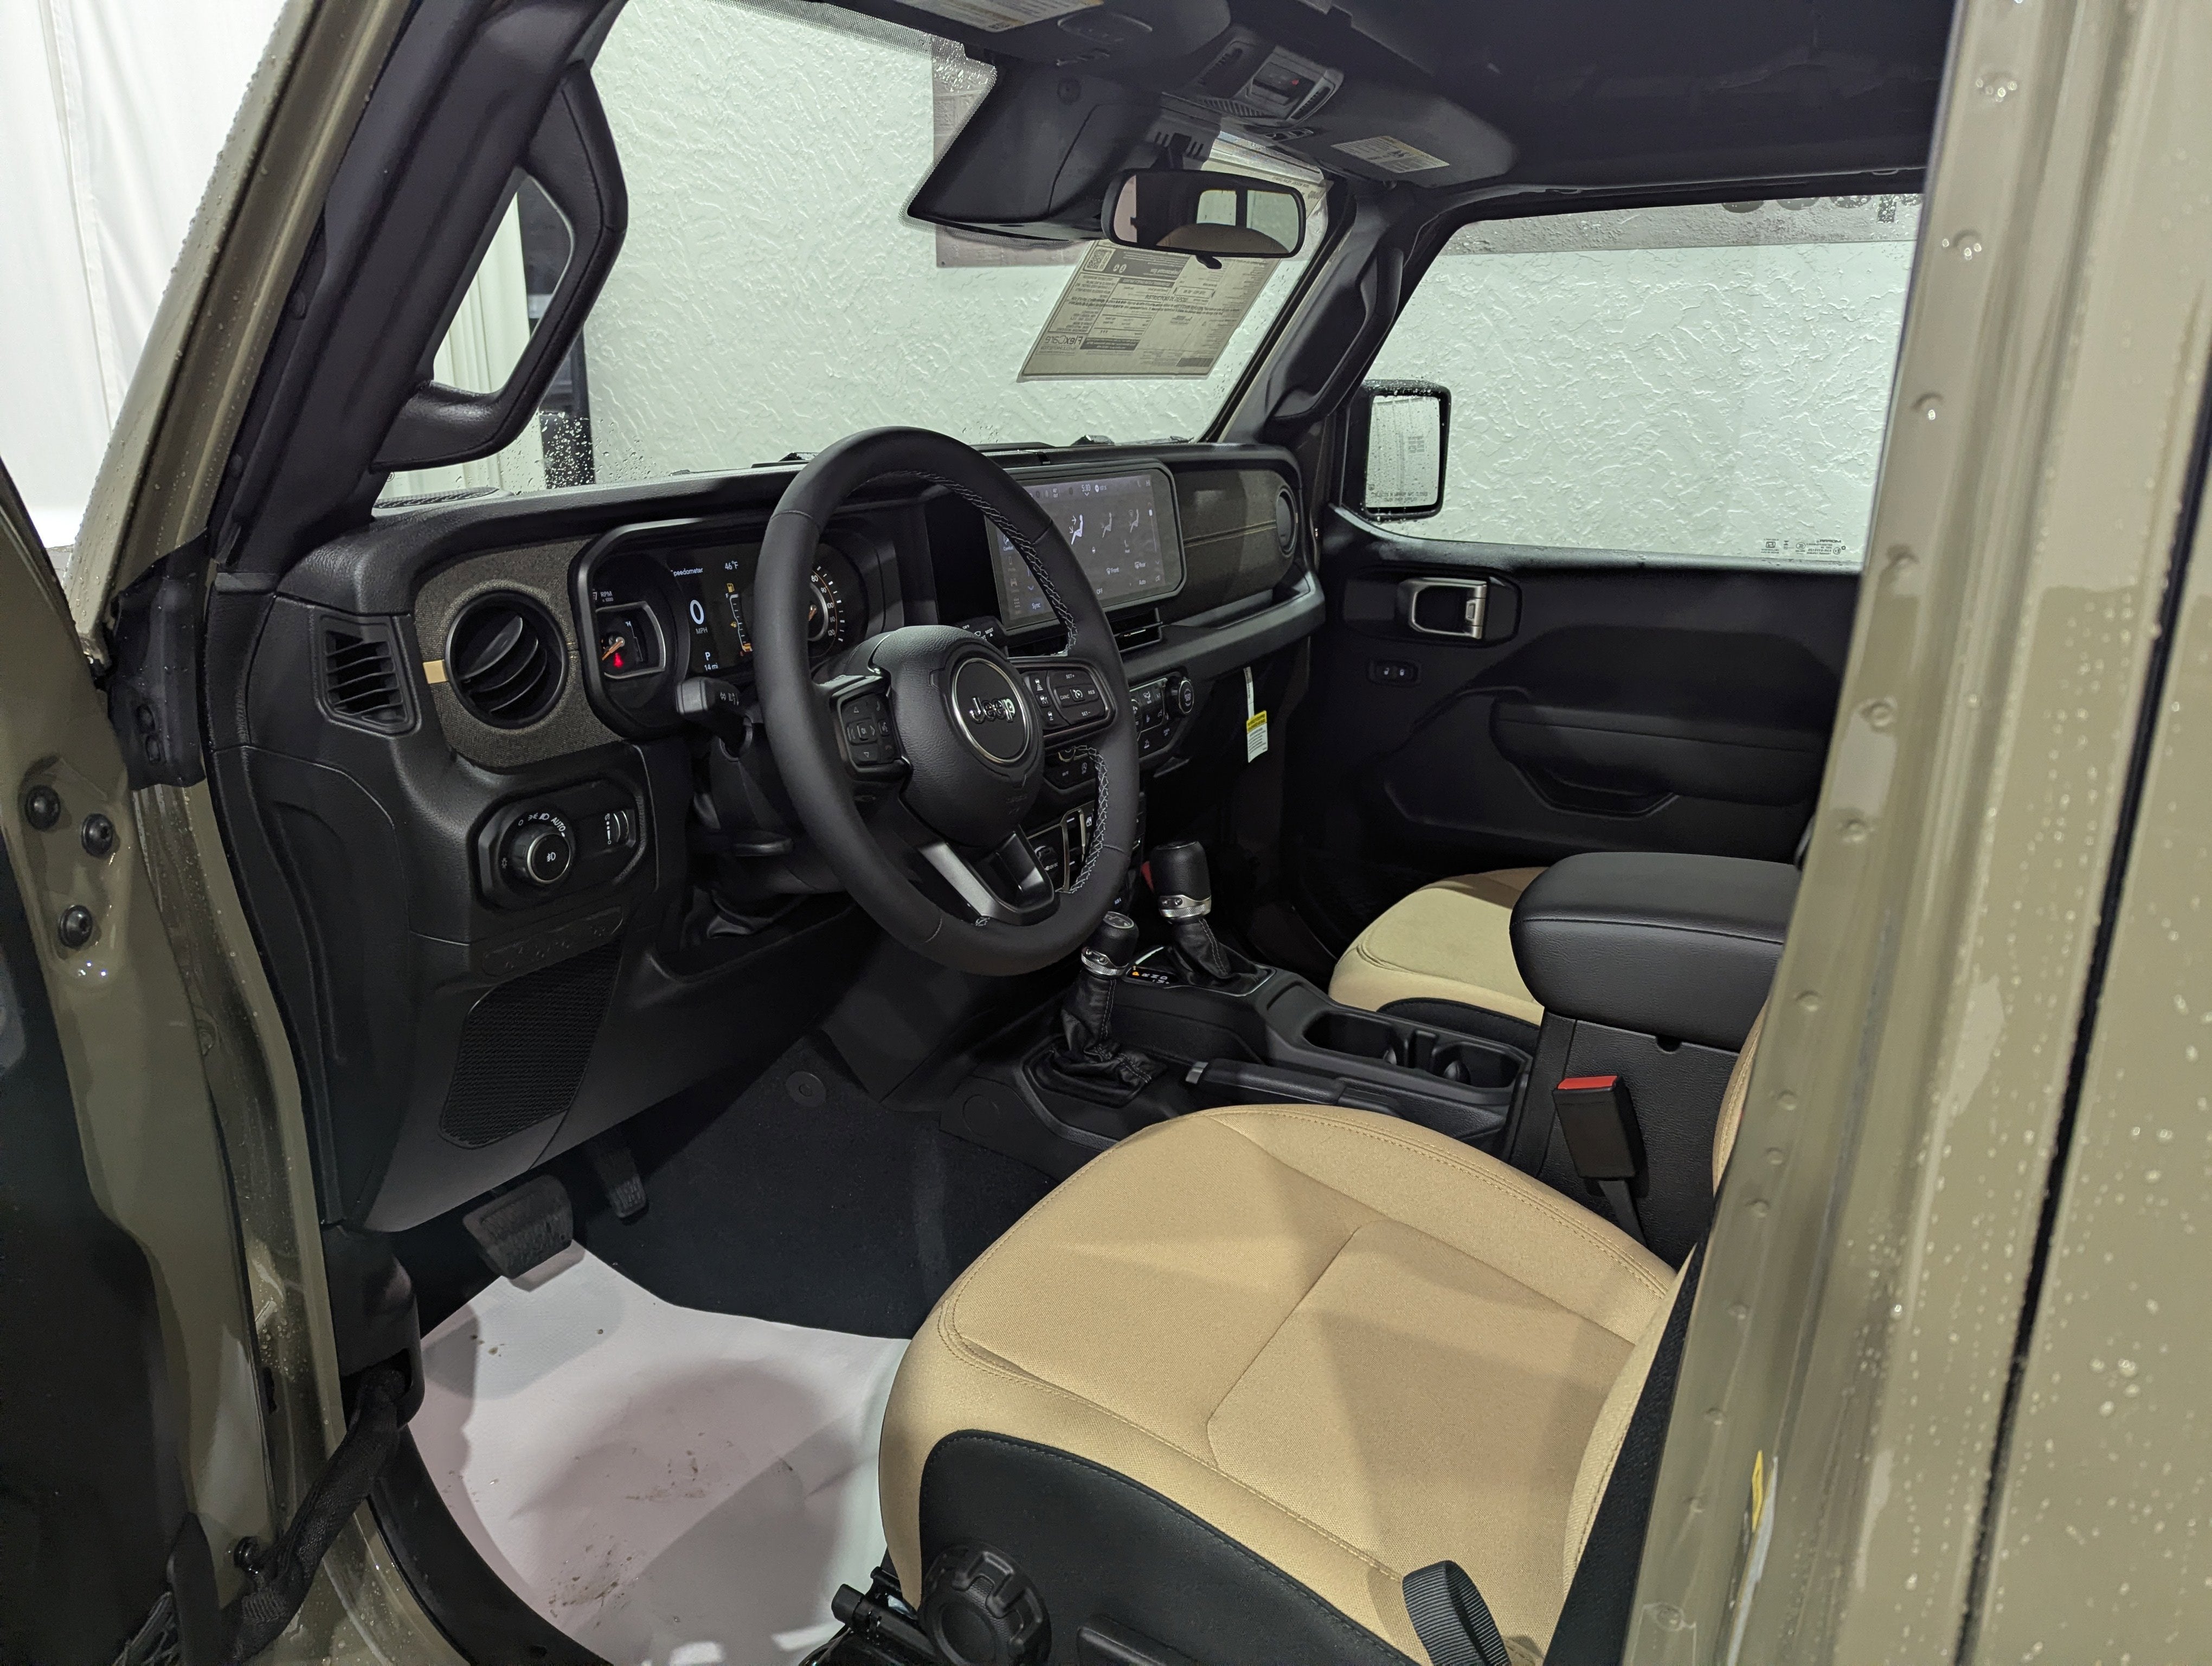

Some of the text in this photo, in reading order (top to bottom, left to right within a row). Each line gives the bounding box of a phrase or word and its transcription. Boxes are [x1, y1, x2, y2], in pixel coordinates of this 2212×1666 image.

[671, 567, 703, 576] peedometer
[689, 599, 704, 624] 0
[705, 652, 711, 661] P
[969, 696, 1016, 723] Jeep
[551, 817, 566, 832] AUTO
